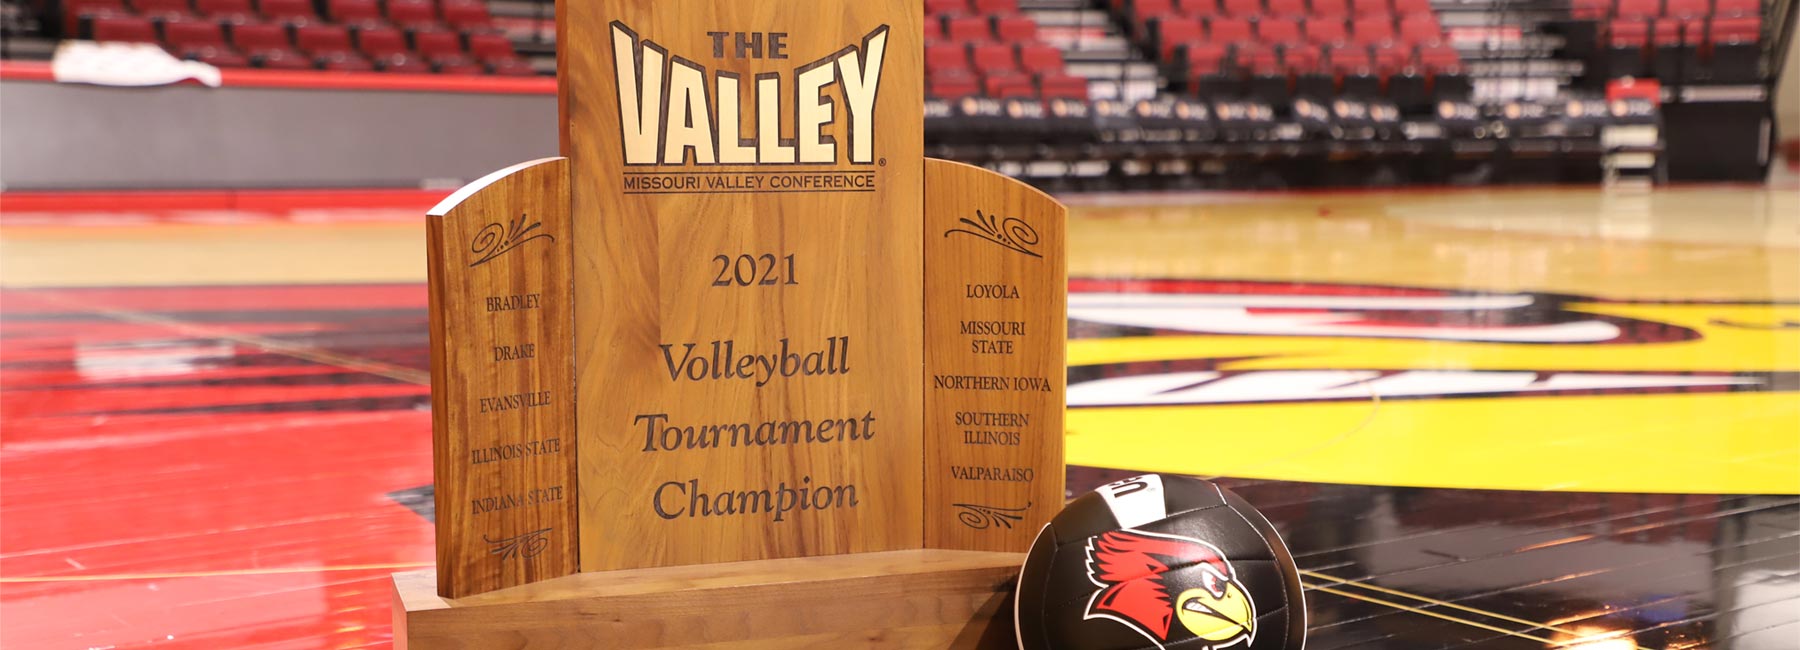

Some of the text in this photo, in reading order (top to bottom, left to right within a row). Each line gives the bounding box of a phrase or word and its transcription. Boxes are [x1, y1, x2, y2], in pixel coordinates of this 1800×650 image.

[707, 31, 788, 59] THE
[609, 20, 890, 166] VALLEY
[624, 174, 875, 190] MISSOURI VALLEY CONFERENCE
[711, 253, 799, 287] 2021
[966, 284, 1020, 299] LOYOLA
[486, 294, 540, 312] BRADLEY
[960, 321, 1026, 336] MISSOURI
[494, 343, 536, 362] DRAKE
[972, 340, 1013, 354] STATE
[658, 336, 850, 388] Volleyball
[934, 375, 1052, 392] NORTHERN IOWA
[480, 391, 551, 413] EVANSVILLE
[955, 411, 1030, 427] SOUTHERN
[633, 411, 876, 452] Tournament
[964, 430, 1020, 446] ILLINOIS
[472, 438, 561, 464] ILLINOIS STATE
[951, 466, 1034, 482] VALPARAISO
[472, 485, 563, 515] INDIANA STATE
[653, 476, 859, 522] Champion
